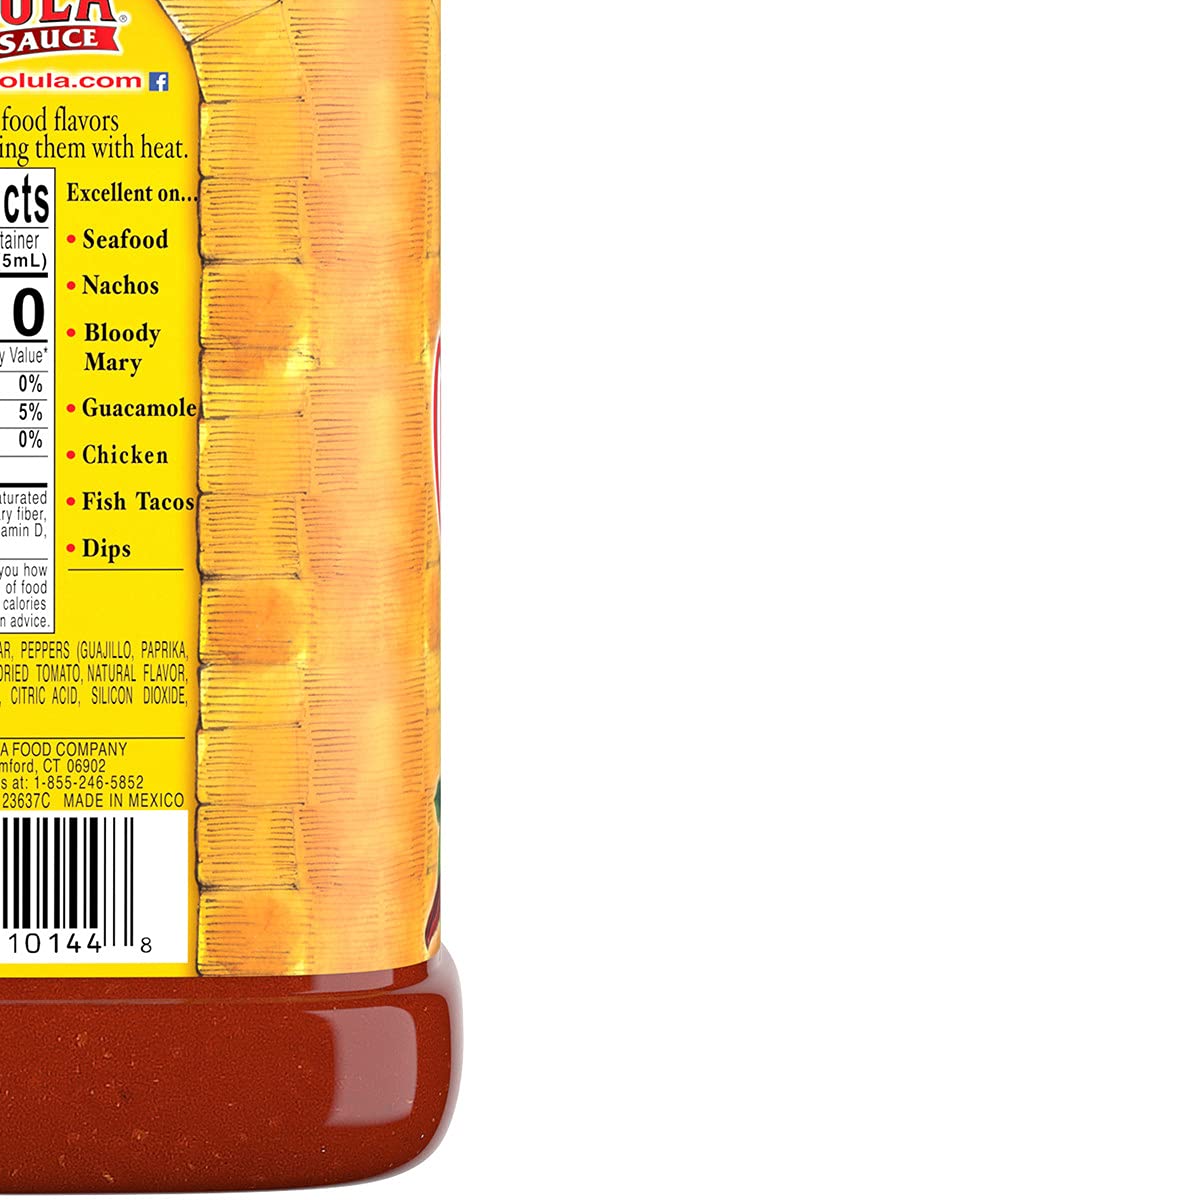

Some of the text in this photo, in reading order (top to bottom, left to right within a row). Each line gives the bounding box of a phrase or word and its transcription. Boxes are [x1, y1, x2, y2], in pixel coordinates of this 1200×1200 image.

[2, 106, 46, 131] food
[54, 106, 118, 131] flavors
[36, 134, 85, 158] them
[92, 134, 134, 158] with
[141, 134, 188, 158] heat.
[67, 182, 152, 201] Excellent
[83, 228, 168, 249] Seafood
[82, 274, 158, 294] Nachos
[13, 288, 44, 336] 0
[85, 322, 161, 348] Bloody
[84, 352, 142, 377] Mary
[19, 374, 42, 392] 0%
[19, 403, 42, 421] 5%
[83, 397, 197, 417] Guacamole
[19, 430, 42, 448] 0%
[83, 444, 168, 464] Chicken
[83, 491, 195, 510] Fish Tacos
[17, 506, 46, 522] fiber,
[83, 538, 130, 563] Dips
[24, 563, 47, 577] how
[22, 580, 47, 594] food
[3, 596, 46, 610] calories
[10, 614, 50, 627] advice.
[21, 641, 69, 659] PEPPERS
[77, 641, 134, 661] (GUAJILLO,
[142, 641, 188, 661] PAPRIKA,
[36, 664, 83, 682] TOMATO,
[88, 664, 136, 682] NATURAL
[144, 663, 188, 684] FLAVOR,
[11, 686, 45, 704] CITRIC
[52, 686, 80, 706] ACID,
[92, 686, 132, 704] SILICON
[144, 686, 187, 707] DIOXIDE,
[13, 742, 51, 757] FOOD
[56, 742, 127, 756] COMPANY
[43, 758, 60, 773] CT
[67, 759, 105, 773] 06902
[12, 776, 27, 789] at:
[35, 775, 143, 789] 1-855-246-5852
[3, 792, 50, 808] 23637C
[64, 793, 103, 807] MADE
[110, 793, 122, 807] IN
[129, 792, 184, 807] MEXICO
[9, 933, 101, 953] 10144
[141, 937, 151, 953] 8
